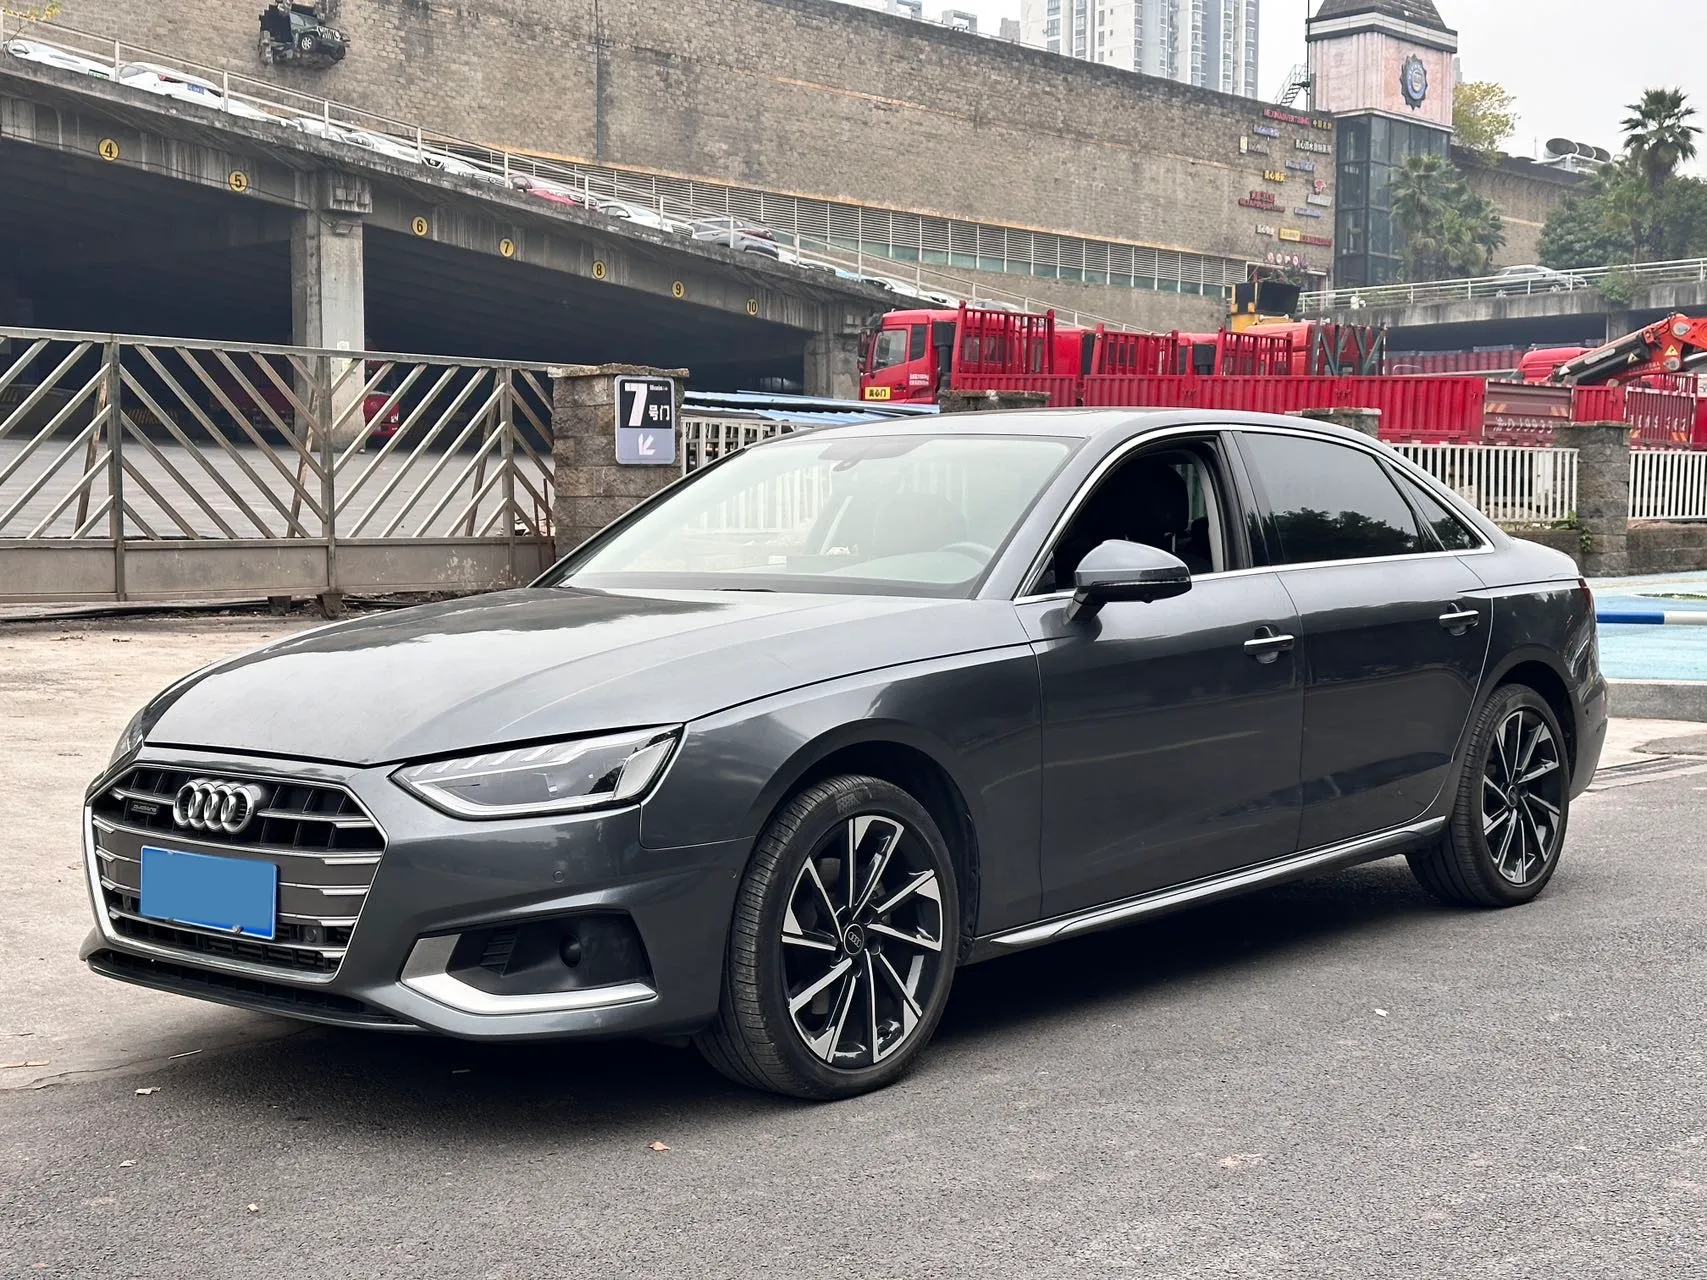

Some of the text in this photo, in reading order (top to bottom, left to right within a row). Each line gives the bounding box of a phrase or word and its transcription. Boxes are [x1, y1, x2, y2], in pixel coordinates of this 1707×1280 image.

[104, 142, 113, 158] 4
[234, 174, 243, 188] 5
[416, 219, 424, 233] 6
[503, 240, 511, 254] 7
[596, 263, 602, 276] 8
[675, 282, 681, 296] 9
[748, 301, 757, 313] 10
[624, 382, 670, 427] 7 号门
